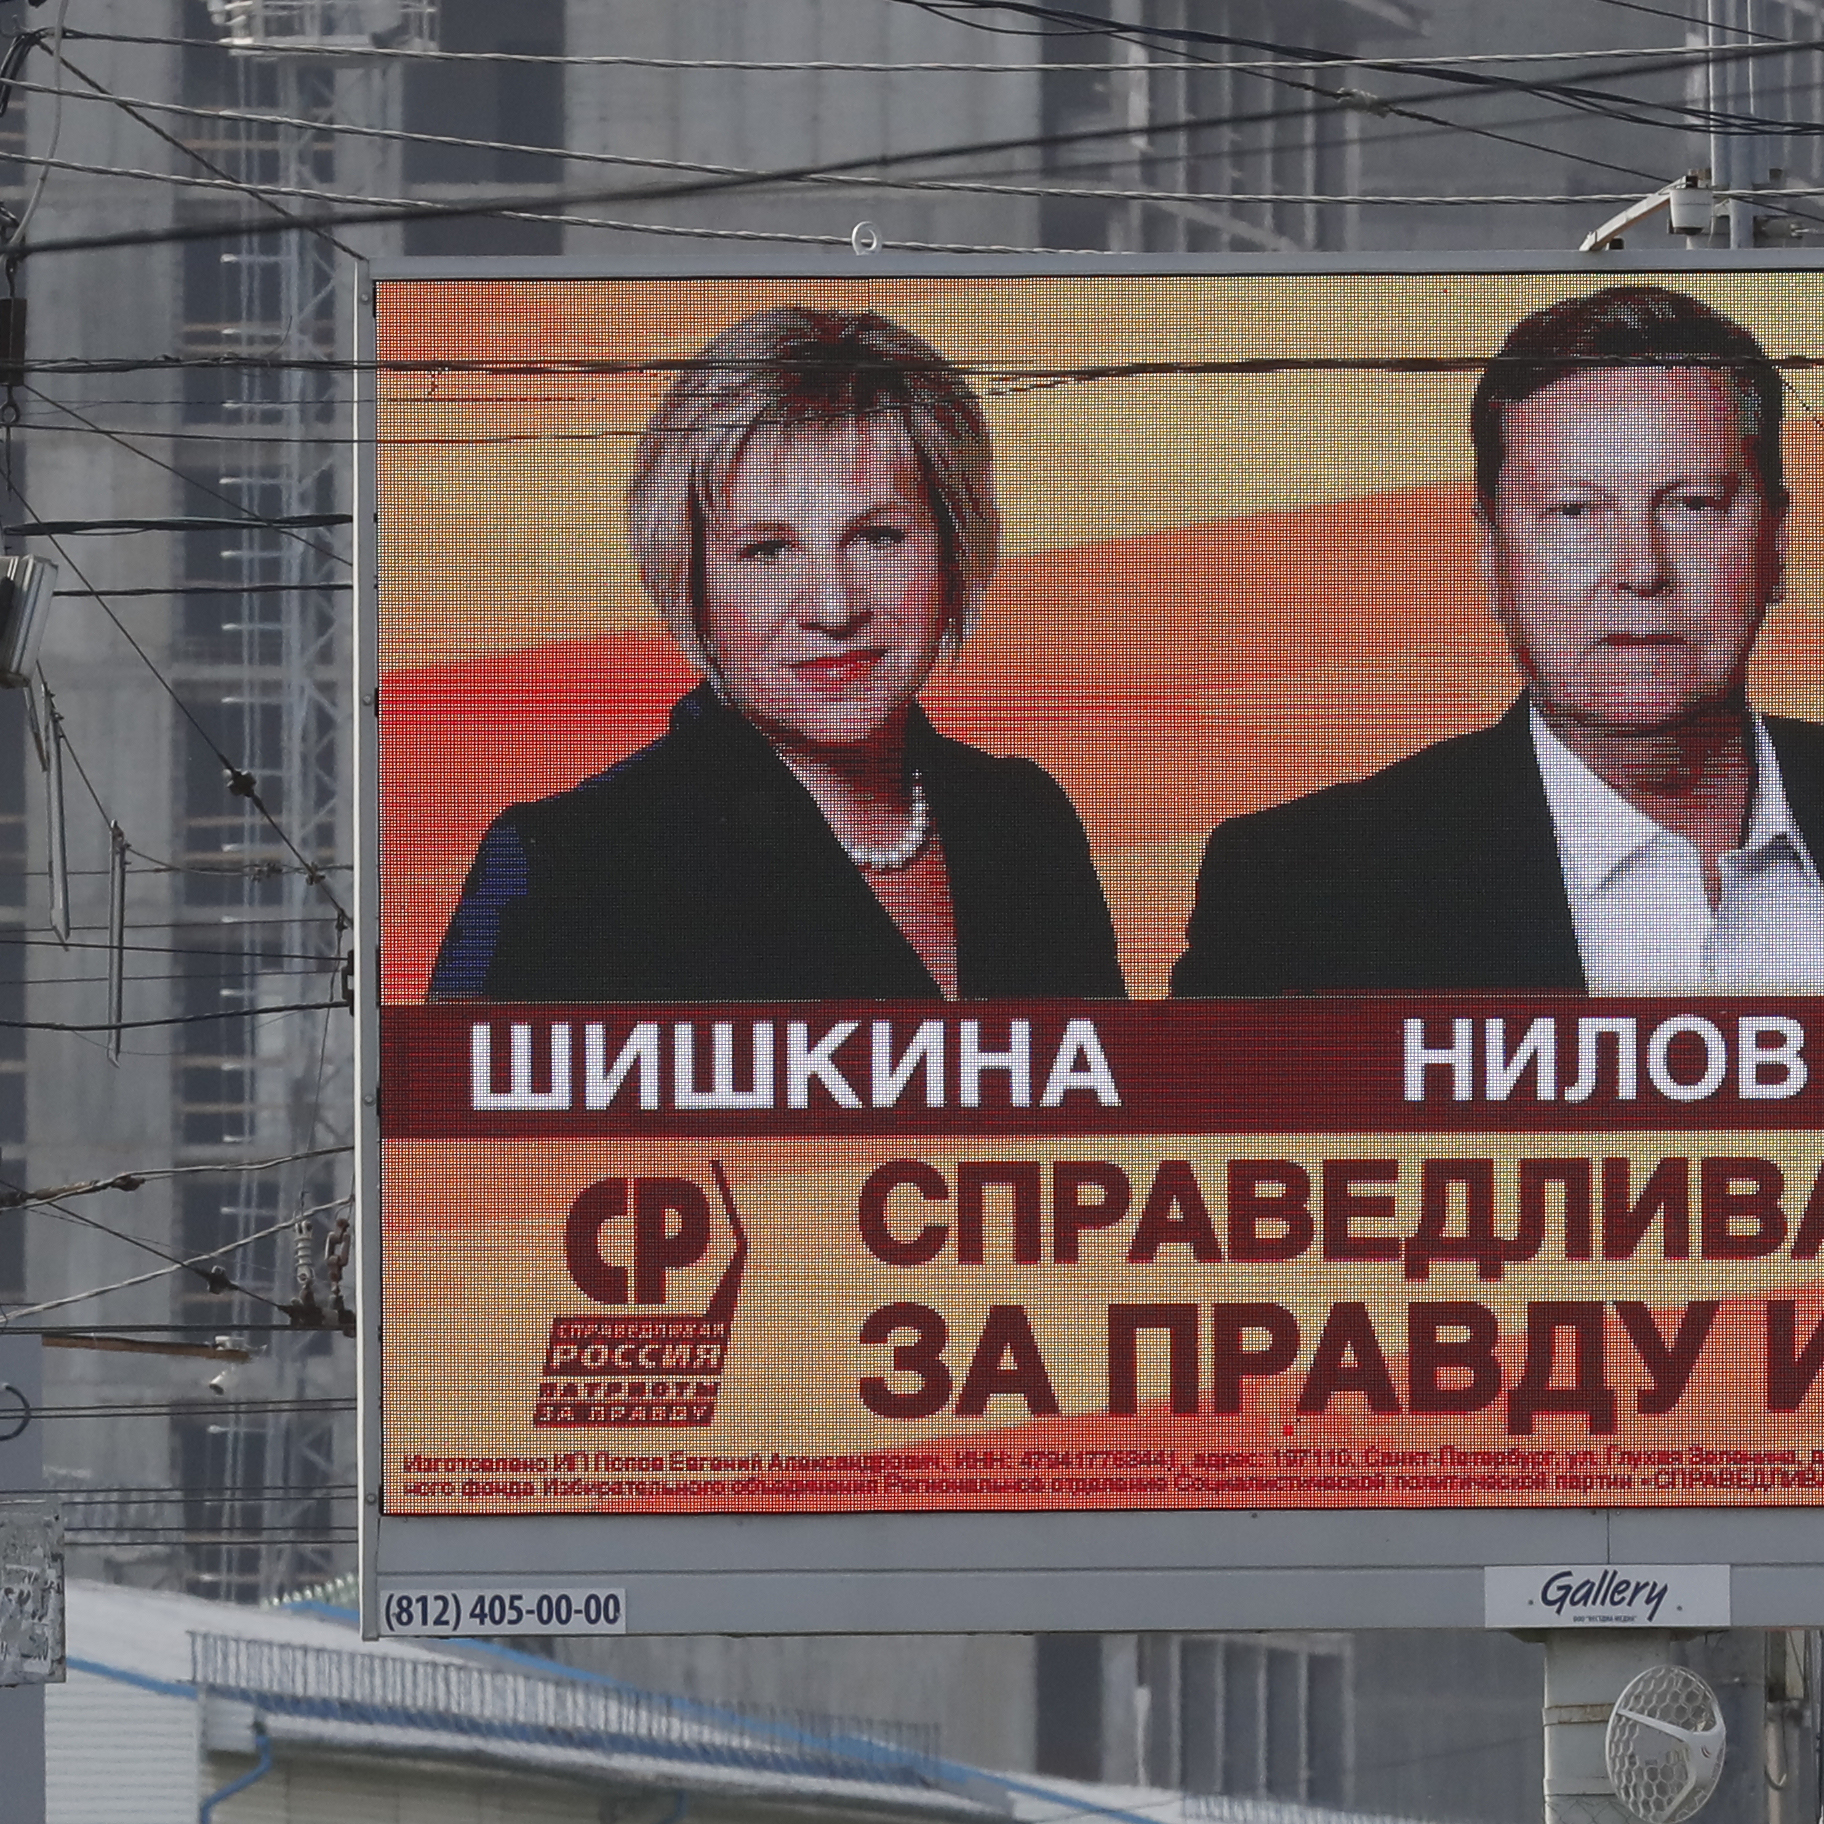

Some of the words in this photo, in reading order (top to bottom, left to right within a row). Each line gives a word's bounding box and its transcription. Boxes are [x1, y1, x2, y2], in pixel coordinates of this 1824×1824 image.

[470, 1018, 1122, 1110] ШИШКИНА
[1402, 1014, 1810, 1104] НИЛОВ
[565, 1177, 711, 1305] СР
[551, 1343, 722, 1370] РОССИЯ
[859, 1301, 1060, 1419] ЗА
[1108, 1300, 1723, 1435] ПРАВДУ
[539, 1381, 722, 1398] ПАТРИОТЫ
[539, 1405, 575, 1421] ЗА
[588, 1405, 708, 1421] ПРАВДУ
[385, 1593, 461, 1632] (812)
[468, 1593, 621, 1626] 405-00-00
[1541, 1569, 1668, 1623] Gallery
